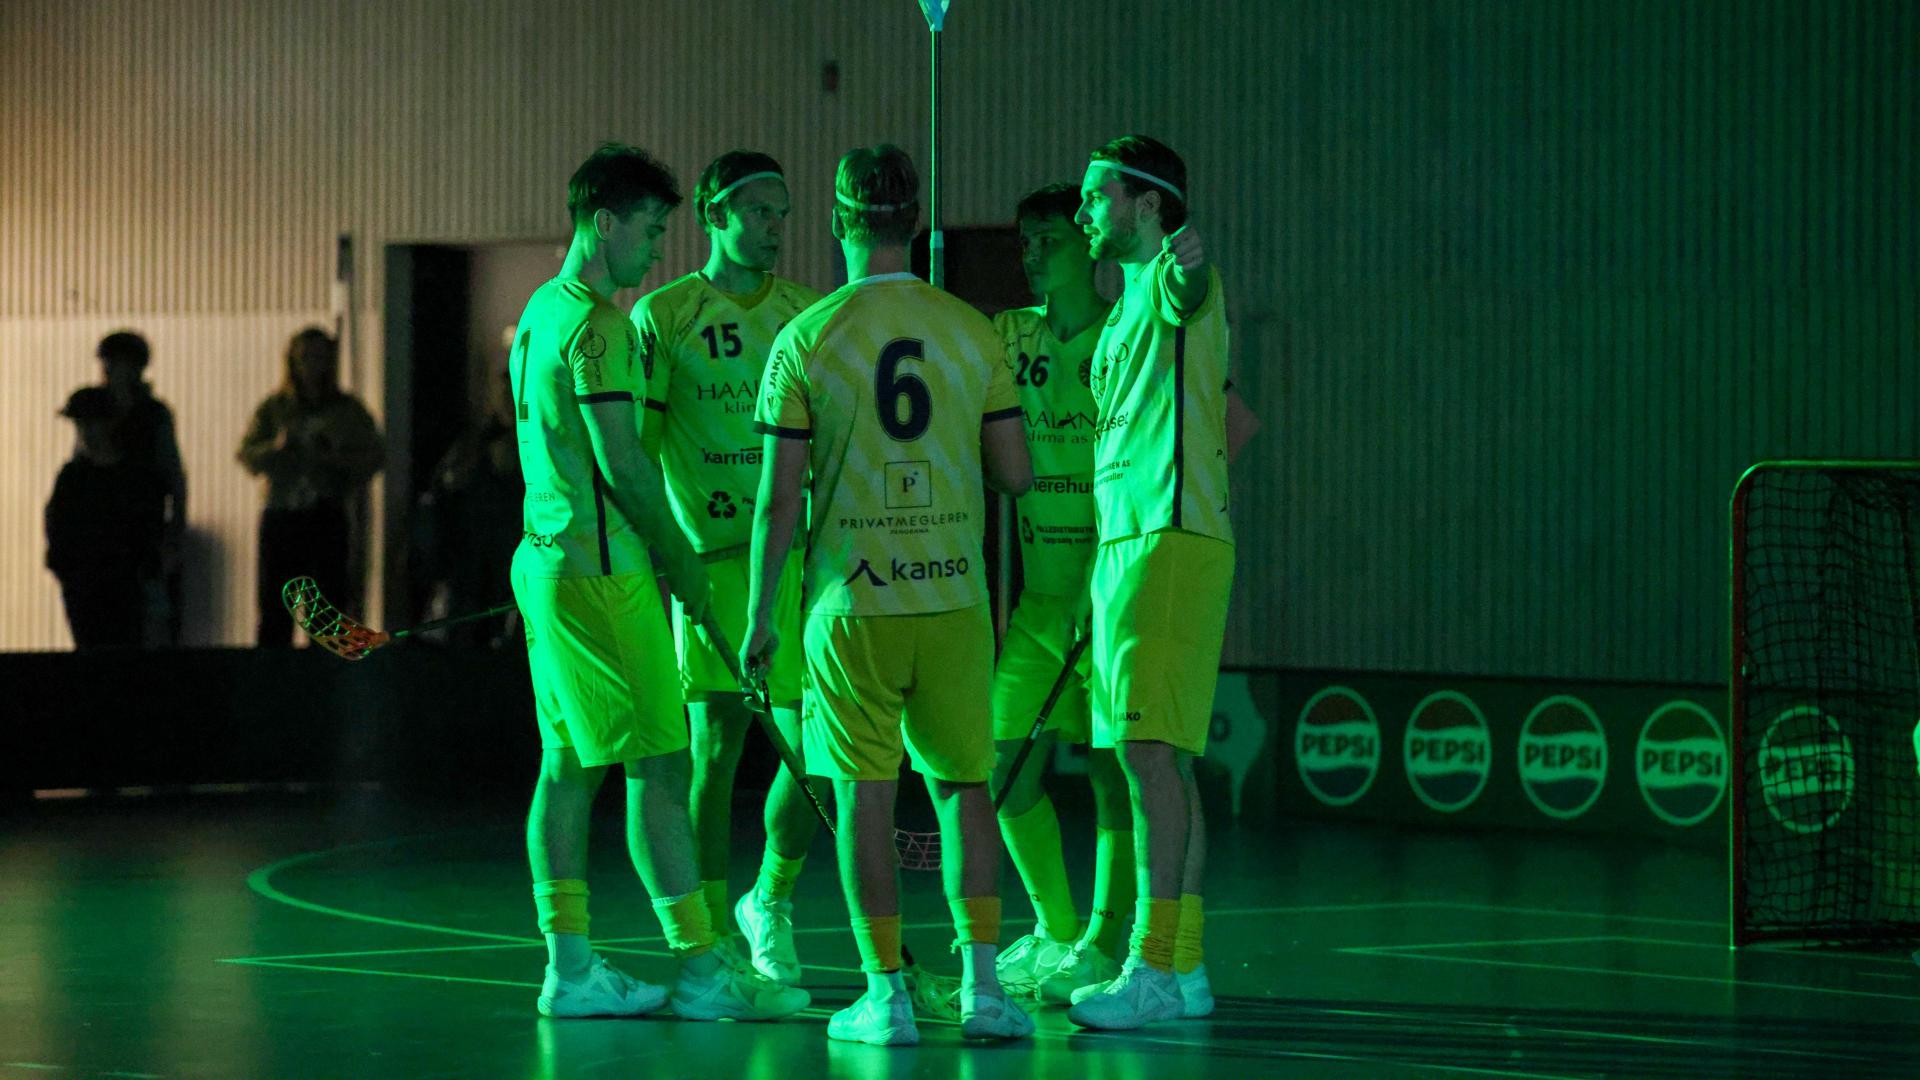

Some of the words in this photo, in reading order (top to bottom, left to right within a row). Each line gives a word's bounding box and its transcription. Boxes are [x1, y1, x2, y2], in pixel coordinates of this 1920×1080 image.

[701, 322, 742, 359] 15
[769, 349, 784, 389] JAKO
[1016, 352, 1050, 388] 26
[875, 336, 932, 442] 6
[840, 512, 969, 529] PRIVATMEGLEREN
[891, 557, 969, 581] kanso
[1303, 734, 1375, 758] PEPSI
[1411, 738, 1485, 763] PEPSI
[1525, 744, 1600, 770] PEPSI
[1643, 749, 1722, 776] PEPSI
